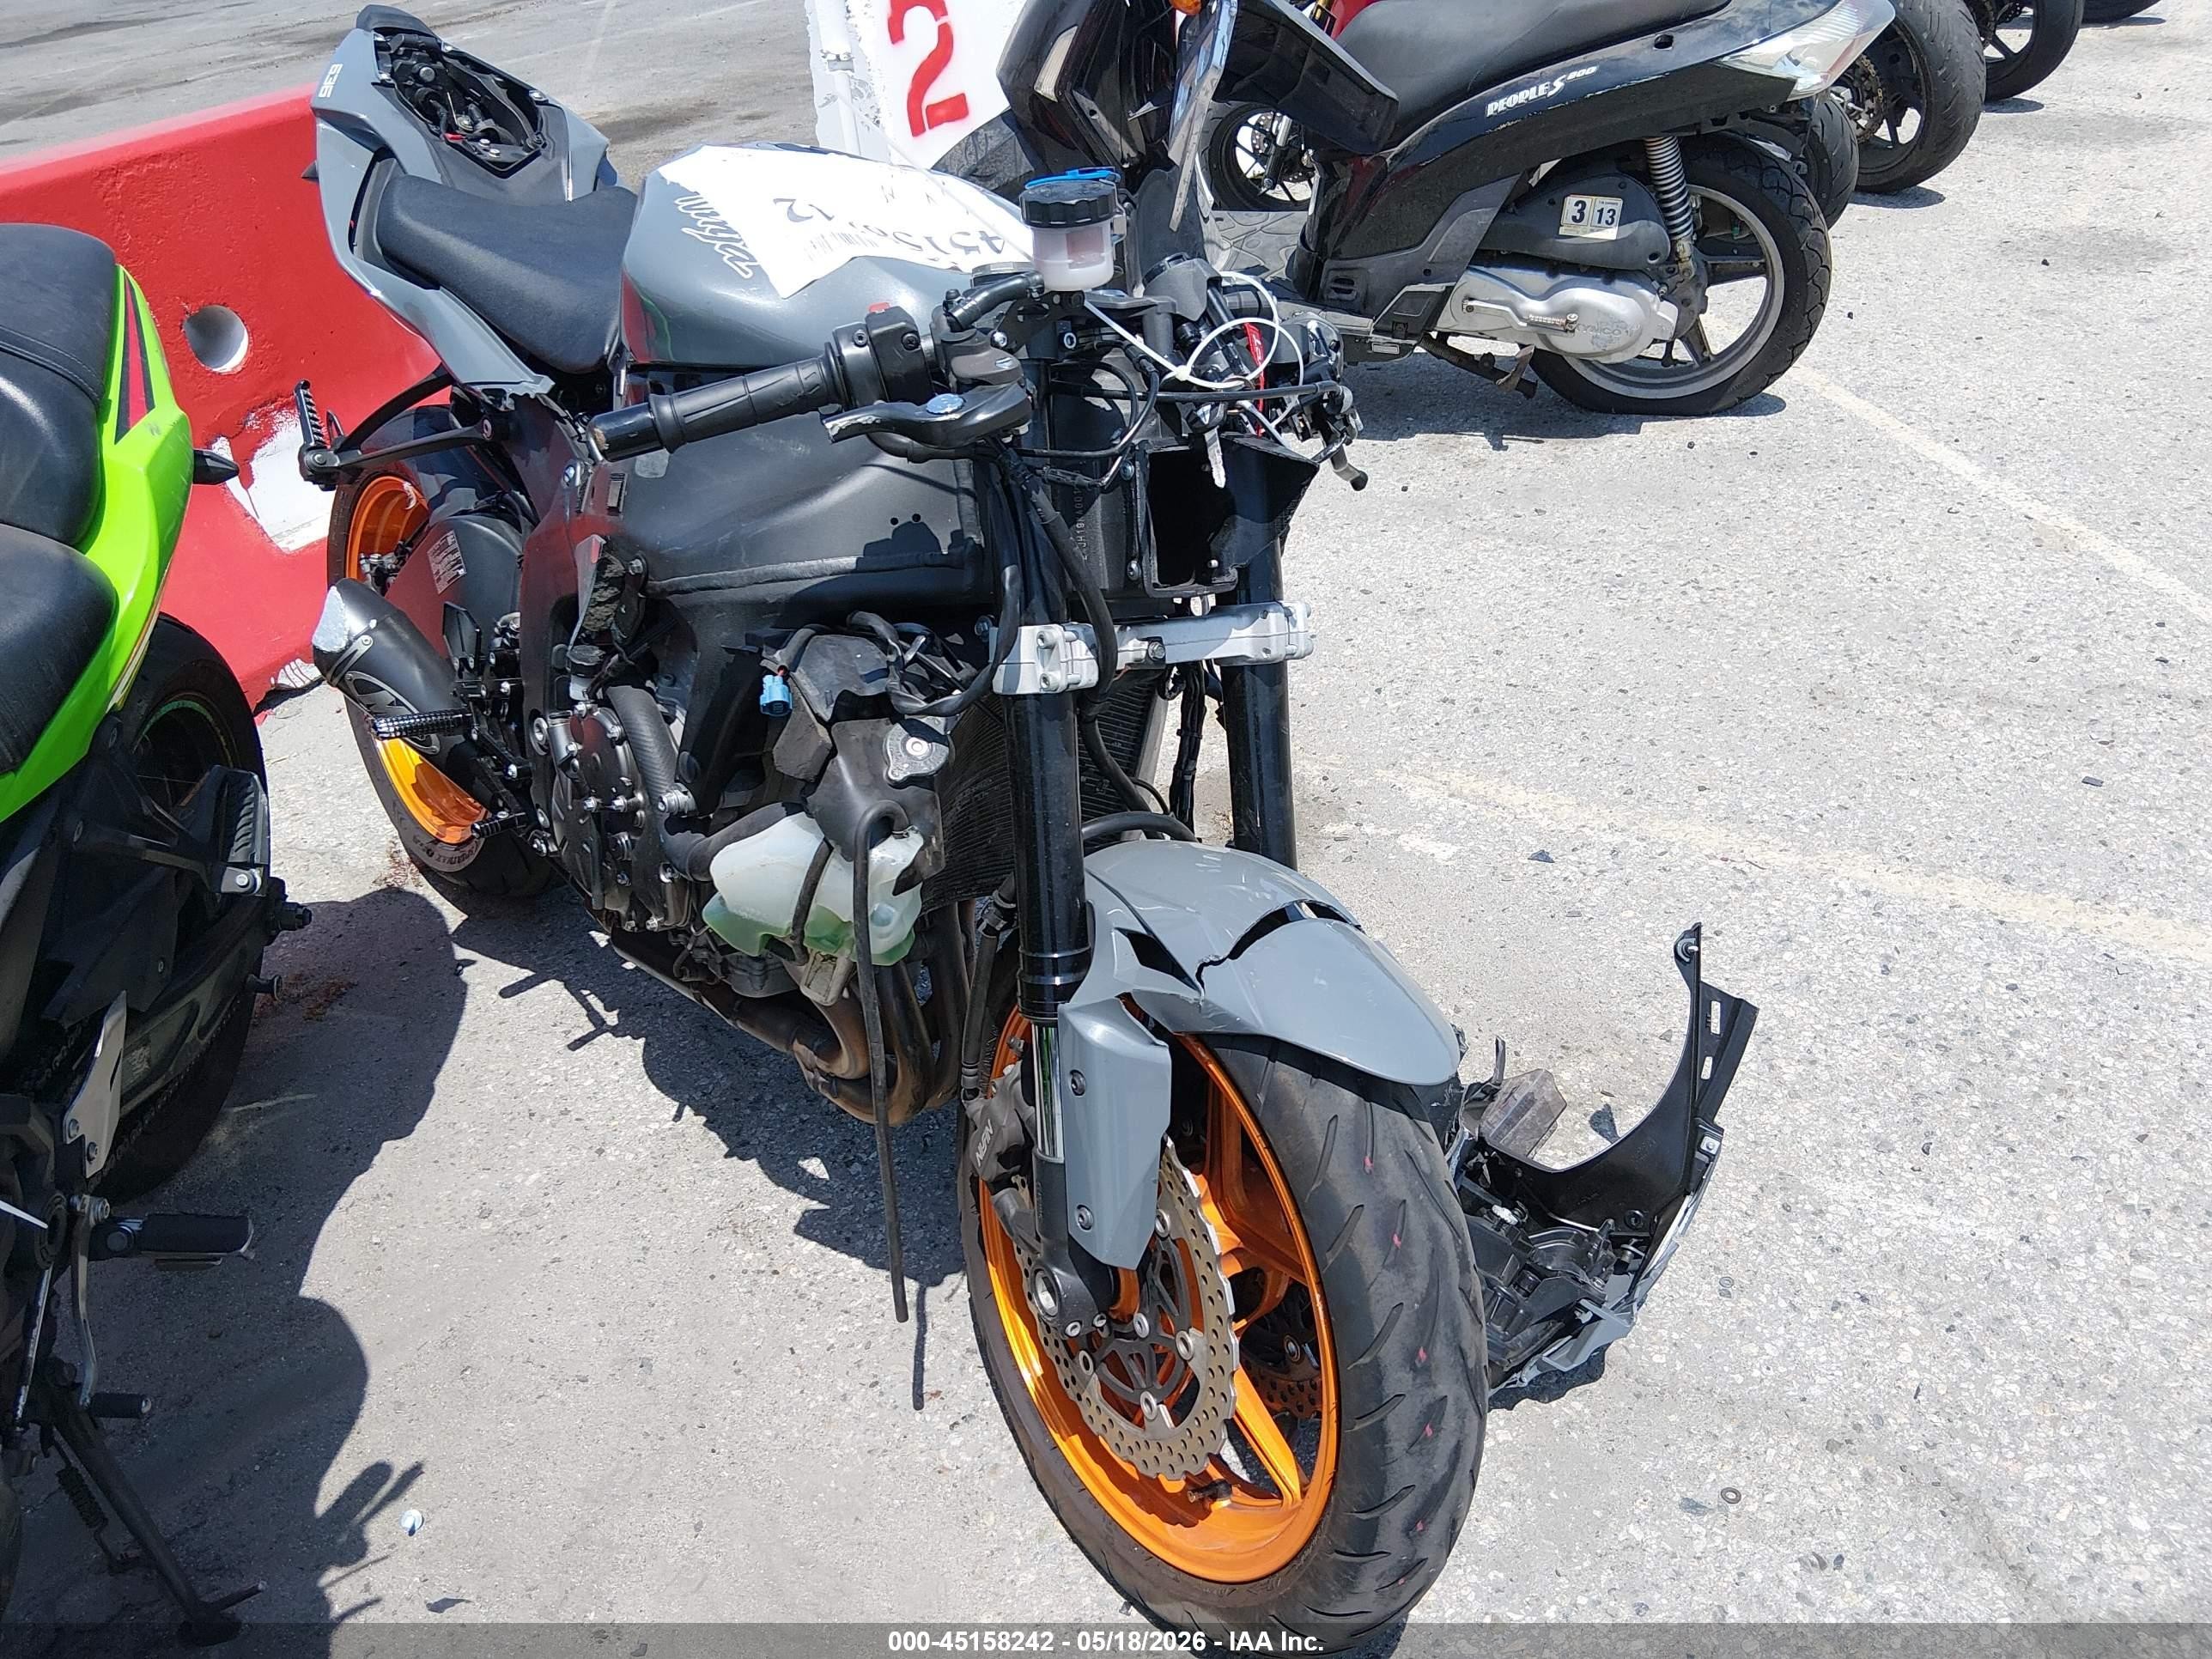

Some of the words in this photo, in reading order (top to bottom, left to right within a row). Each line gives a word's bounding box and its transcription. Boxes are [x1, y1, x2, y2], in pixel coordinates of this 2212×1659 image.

[318, 63, 343, 98] 636
[888, 0, 969, 137] 2
[1486, 82, 1551, 117] PEOPLE
[1571, 199, 1587, 223] 3
[1596, 207, 1616, 226] 13
[674, 195, 762, 279] Ninja
